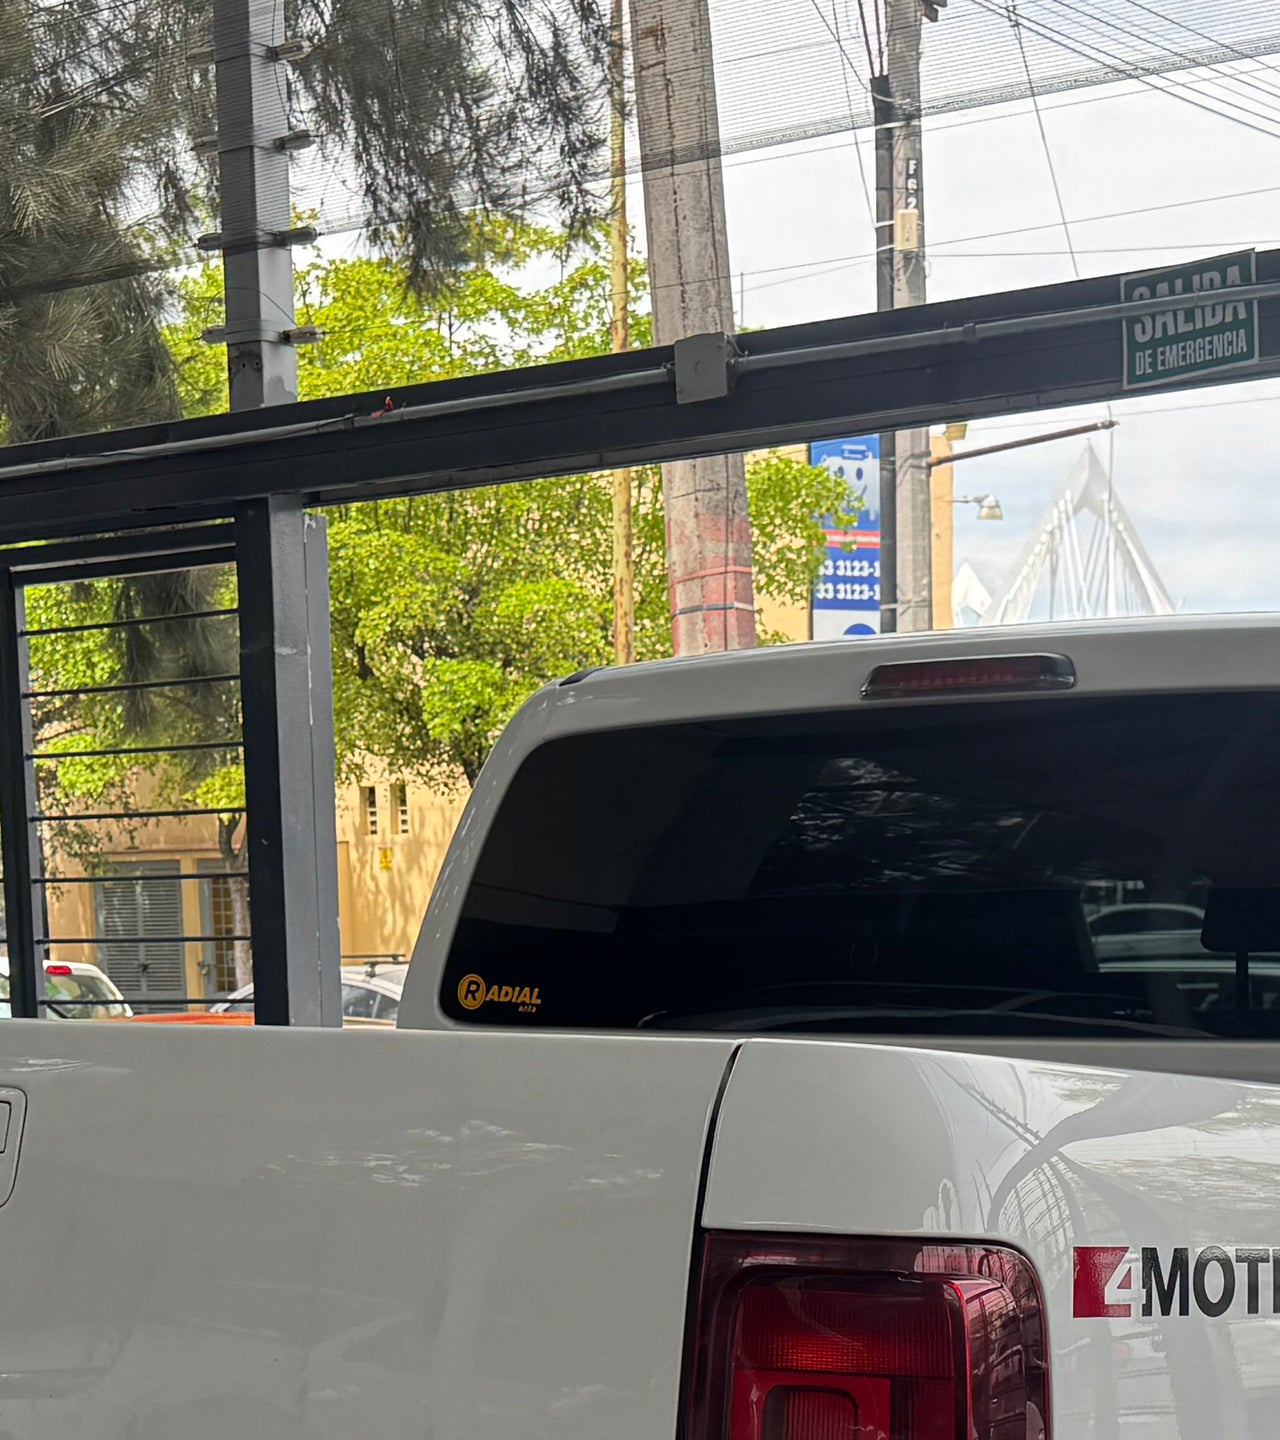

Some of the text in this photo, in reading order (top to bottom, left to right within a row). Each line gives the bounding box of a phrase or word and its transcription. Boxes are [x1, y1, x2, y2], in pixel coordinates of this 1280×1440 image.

[1132, 265, 1247, 343] SALIDA
[1135, 329, 1247, 376] DE EMERGENCIA
[458, 974, 541, 1009] RADIAL
